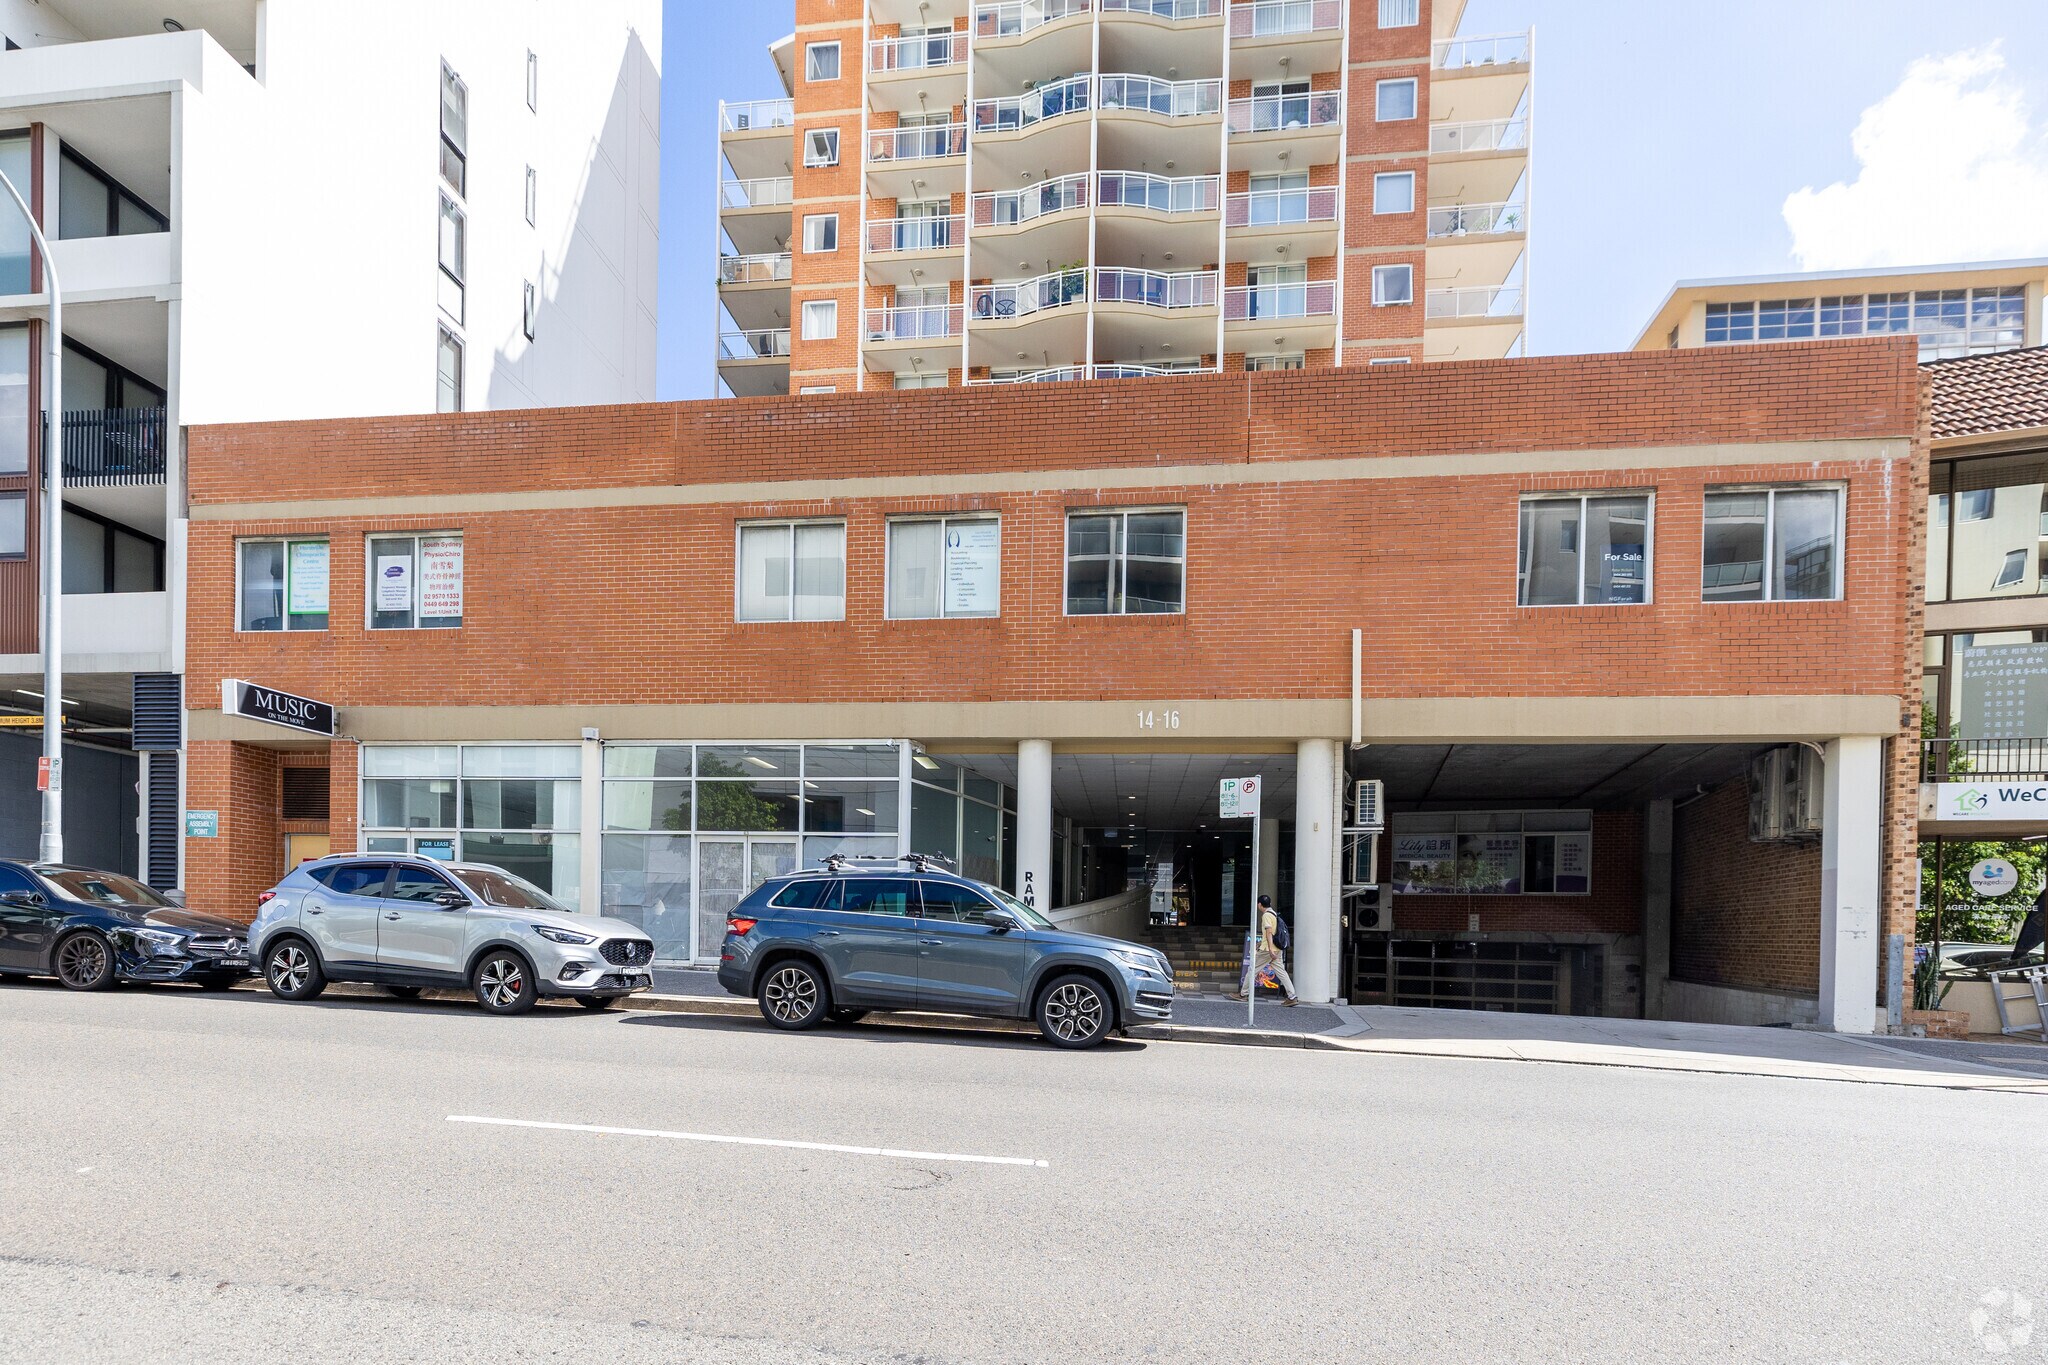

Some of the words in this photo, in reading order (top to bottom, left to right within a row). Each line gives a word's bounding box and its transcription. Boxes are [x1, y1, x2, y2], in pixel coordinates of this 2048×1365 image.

[1604, 553, 1621, 561] For
[1623, 553, 1642, 561] Sale
[254, 689, 317, 720] MUSIC
[277, 714, 288, 722] THE
[289, 717, 305, 726] MOVE
[1136, 710, 1180, 729] 14-16
[1224, 781, 1236, 791] 1P
[187, 812, 217, 820] EMERGENCY
[1398, 839, 1425, 853] Lily
[1999, 904, 2039, 912] SERVICE
